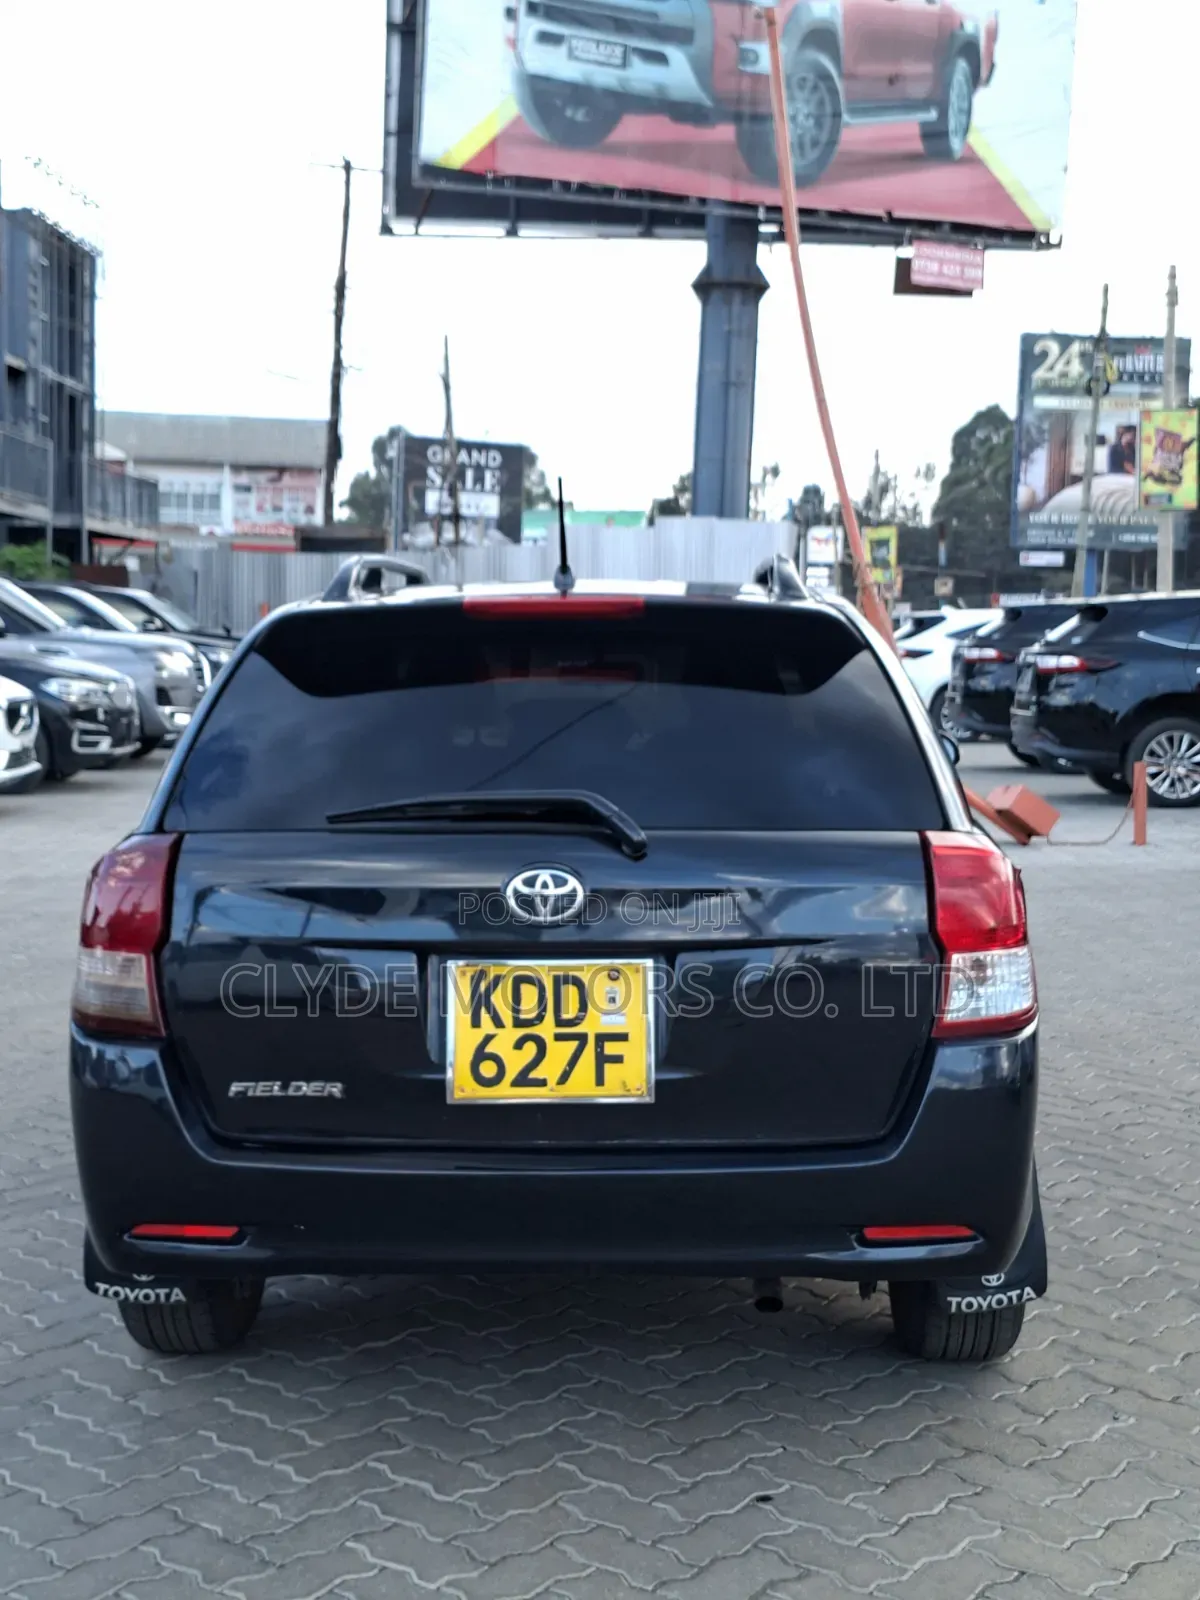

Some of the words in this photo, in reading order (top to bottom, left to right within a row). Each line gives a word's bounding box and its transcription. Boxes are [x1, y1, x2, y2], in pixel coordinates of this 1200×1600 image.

[425, 465, 501, 493] SLE
[469, 968, 589, 1029] KDD
[469, 1031, 630, 1089] 627F
[228, 1081, 345, 1099] FIELDER
[95, 1282, 187, 1304] TOYOTA
[946, 1286, 1037, 1313] TOYOTA
